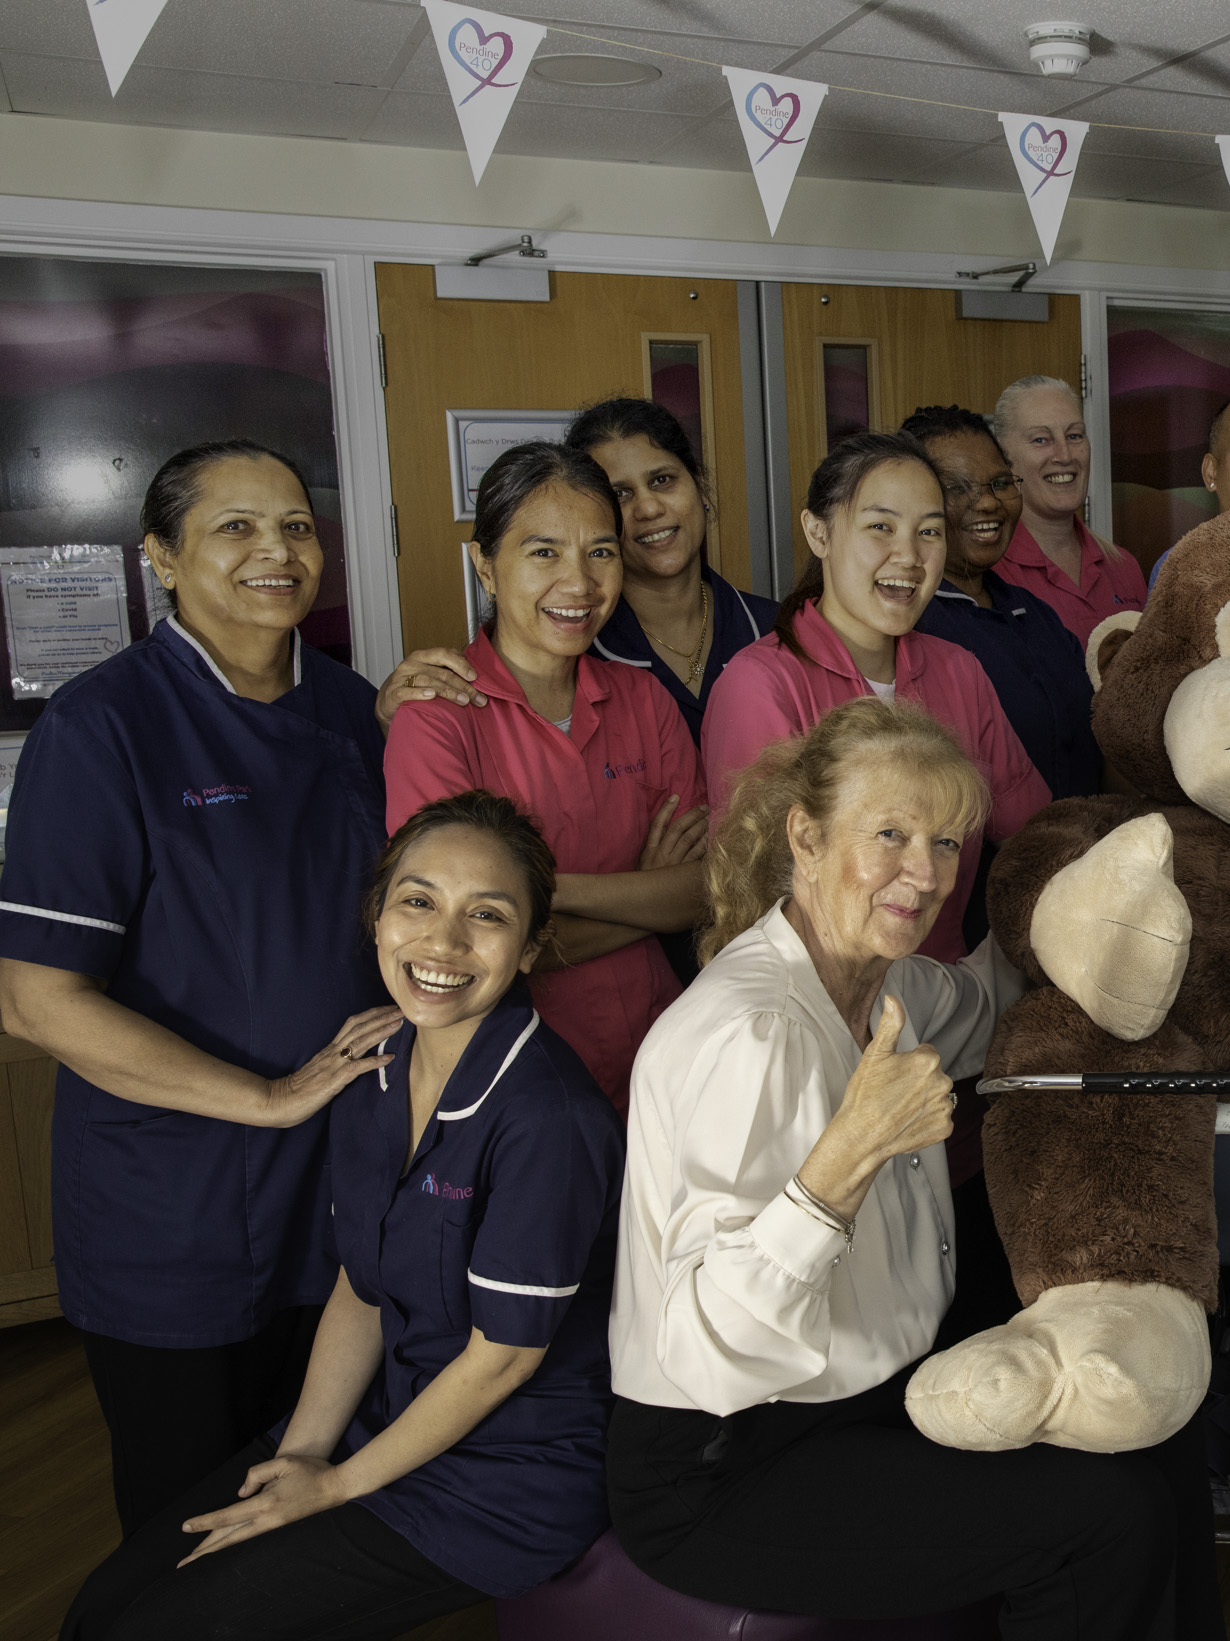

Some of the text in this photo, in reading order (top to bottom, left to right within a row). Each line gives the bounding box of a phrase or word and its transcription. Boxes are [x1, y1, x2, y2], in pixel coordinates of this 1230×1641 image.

[459, 42, 499, 60] Pendine
[470, 56, 492, 71] 40
[755, 105, 790, 119] Pendine
[764, 116, 784, 130] 40
[1028, 143, 1058, 154] Pendine
[1037, 153, 1054, 164] 40
